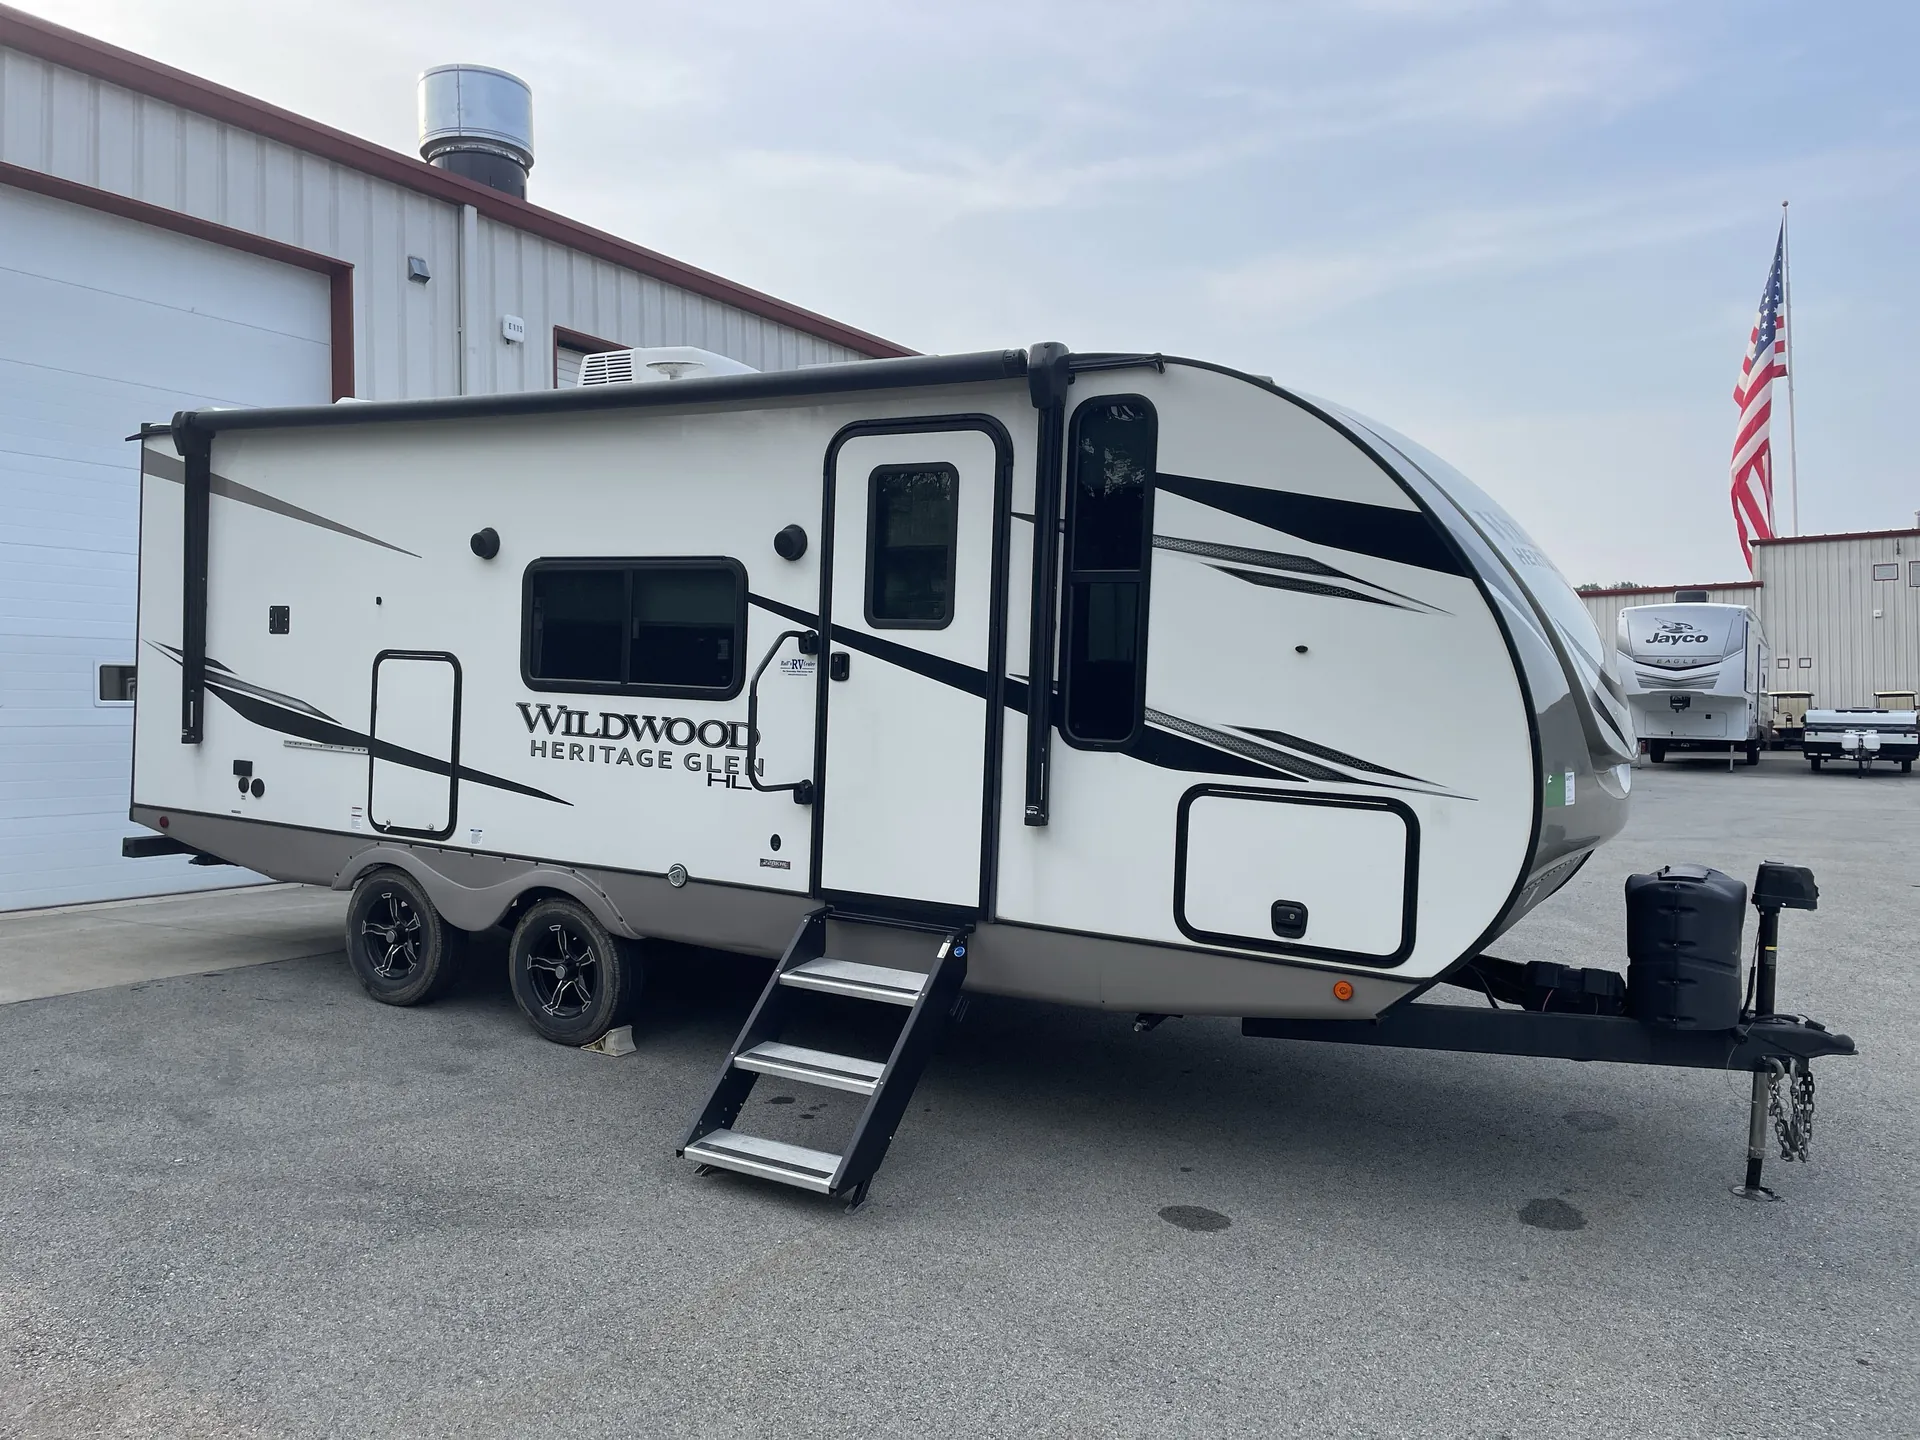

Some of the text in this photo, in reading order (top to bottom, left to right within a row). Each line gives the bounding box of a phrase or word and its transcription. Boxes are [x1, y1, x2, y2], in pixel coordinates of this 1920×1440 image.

[1645, 632, 1709, 646] Jayco
[791, 658, 804, 669] RV
[516, 701, 761, 751] WILDWOOD
[530, 739, 764, 777] HERITAGE GLEN
[707, 772, 752, 791] HL
